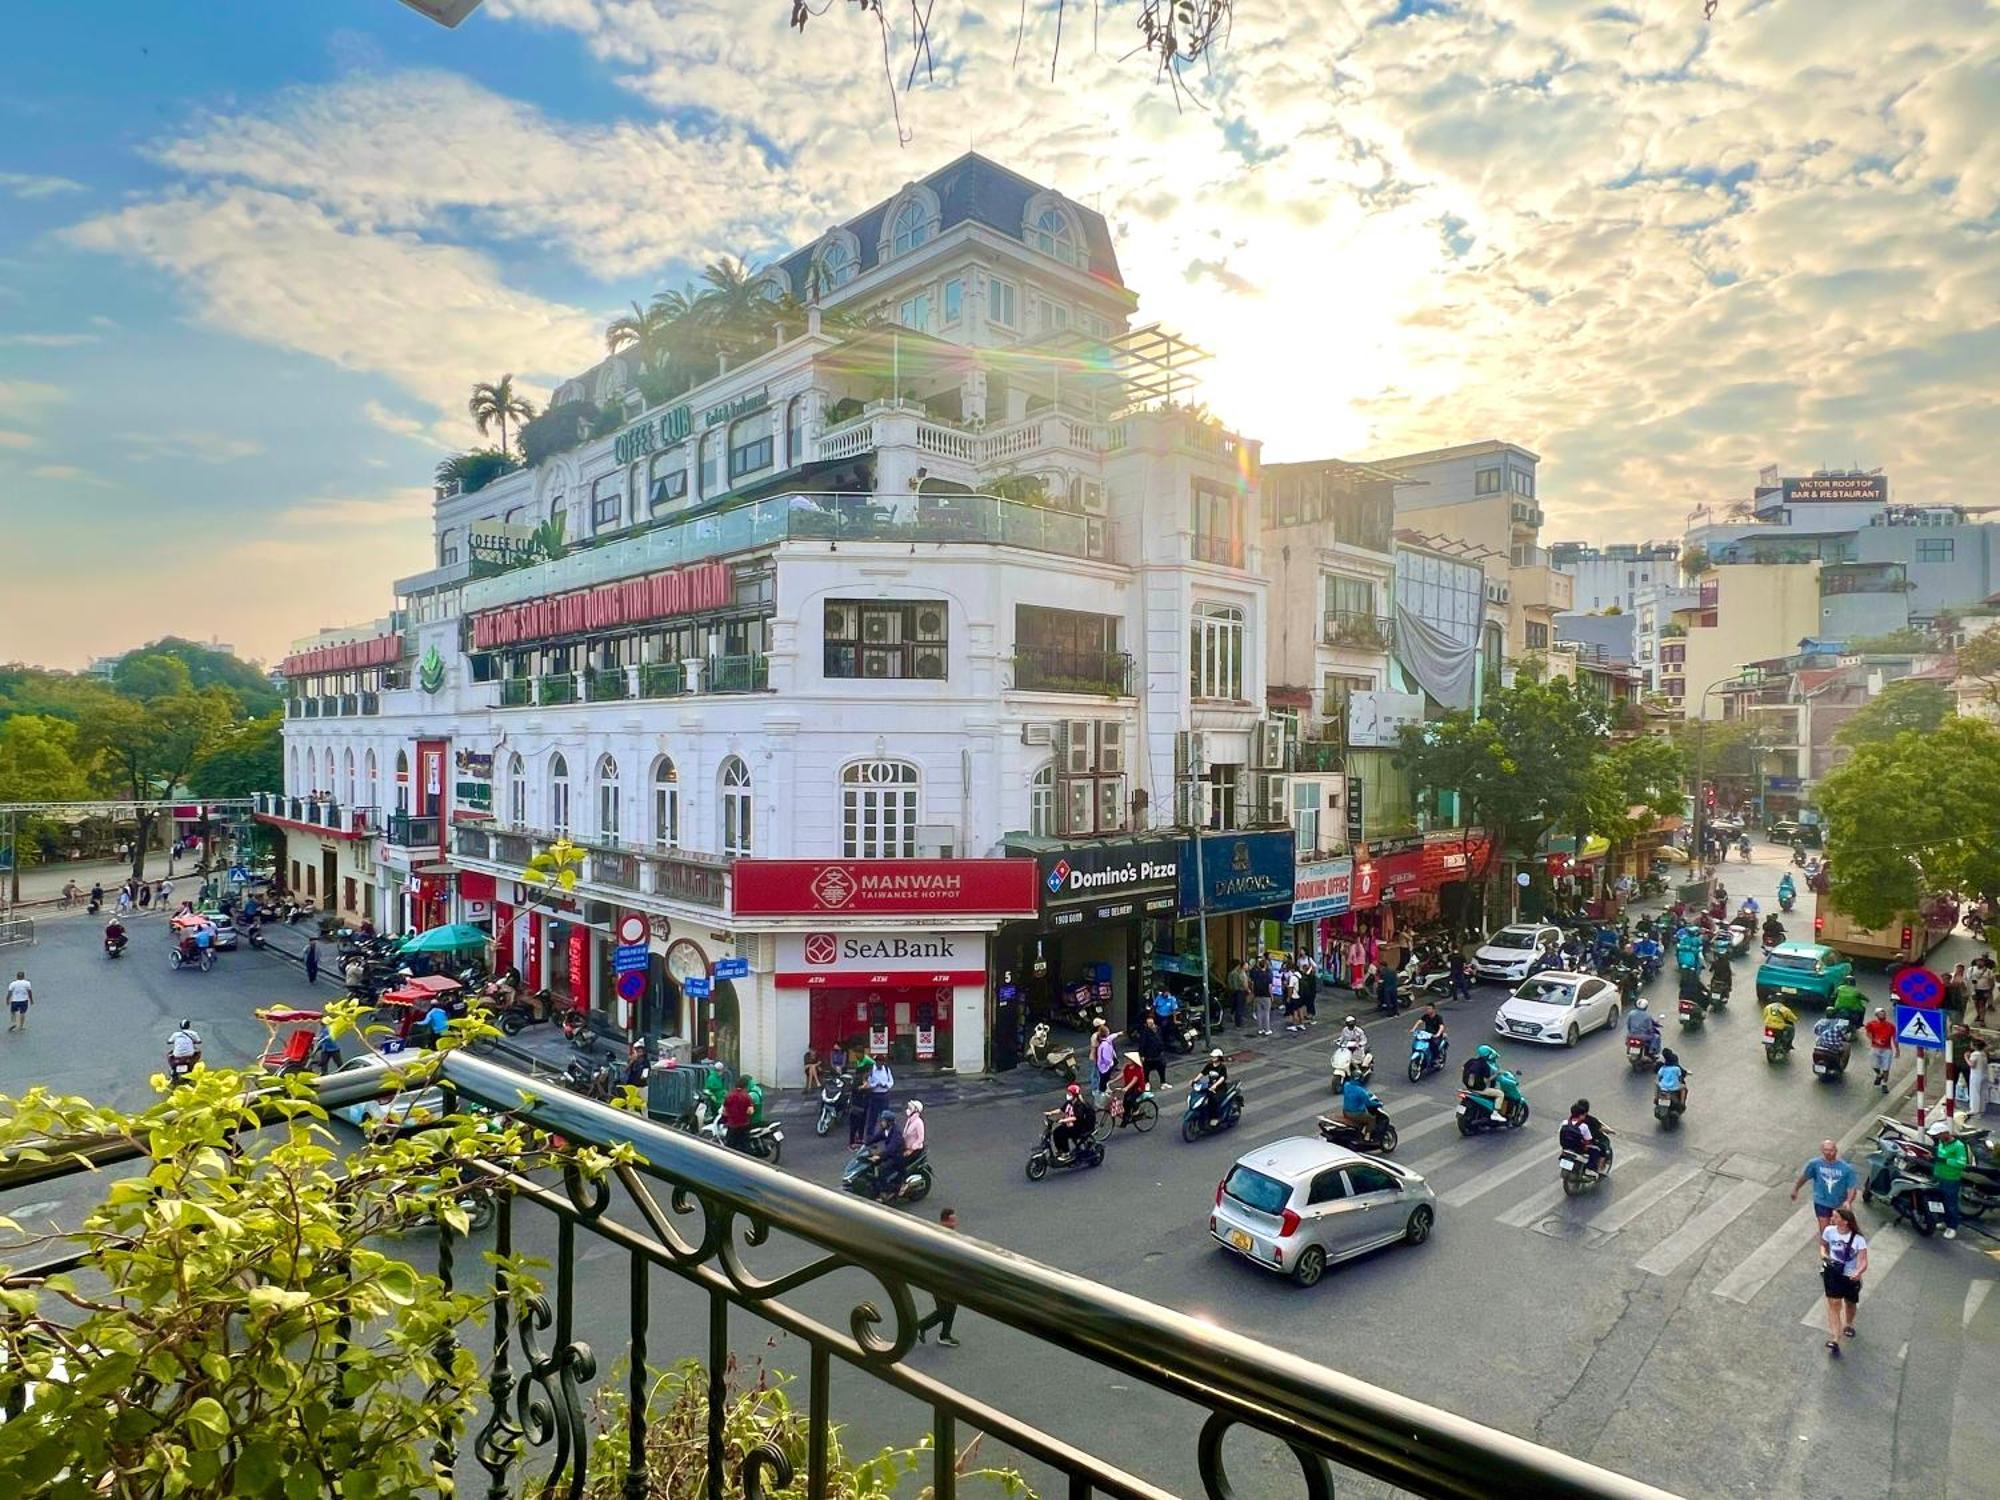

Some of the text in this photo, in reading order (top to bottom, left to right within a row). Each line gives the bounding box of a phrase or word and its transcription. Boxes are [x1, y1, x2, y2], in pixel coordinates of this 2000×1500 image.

[615, 405, 692, 466] COFFEE CLUB
[1820, 490, 1880, 498] RESTAURANT
[468, 532, 510, 552] COFFEE
[862, 875, 961, 889] MANWAH
[1070, 861, 1176, 889] Domino's Pizza
[1295, 879, 1327, 901] BOOKING
[1327, 875, 1349, 895] OFFICE
[844, 937, 954, 958] SeABank
[808, 976, 826, 984] ATM
[871, 975, 888, 983] ATM
[1004, 970, 1012, 983] 5
